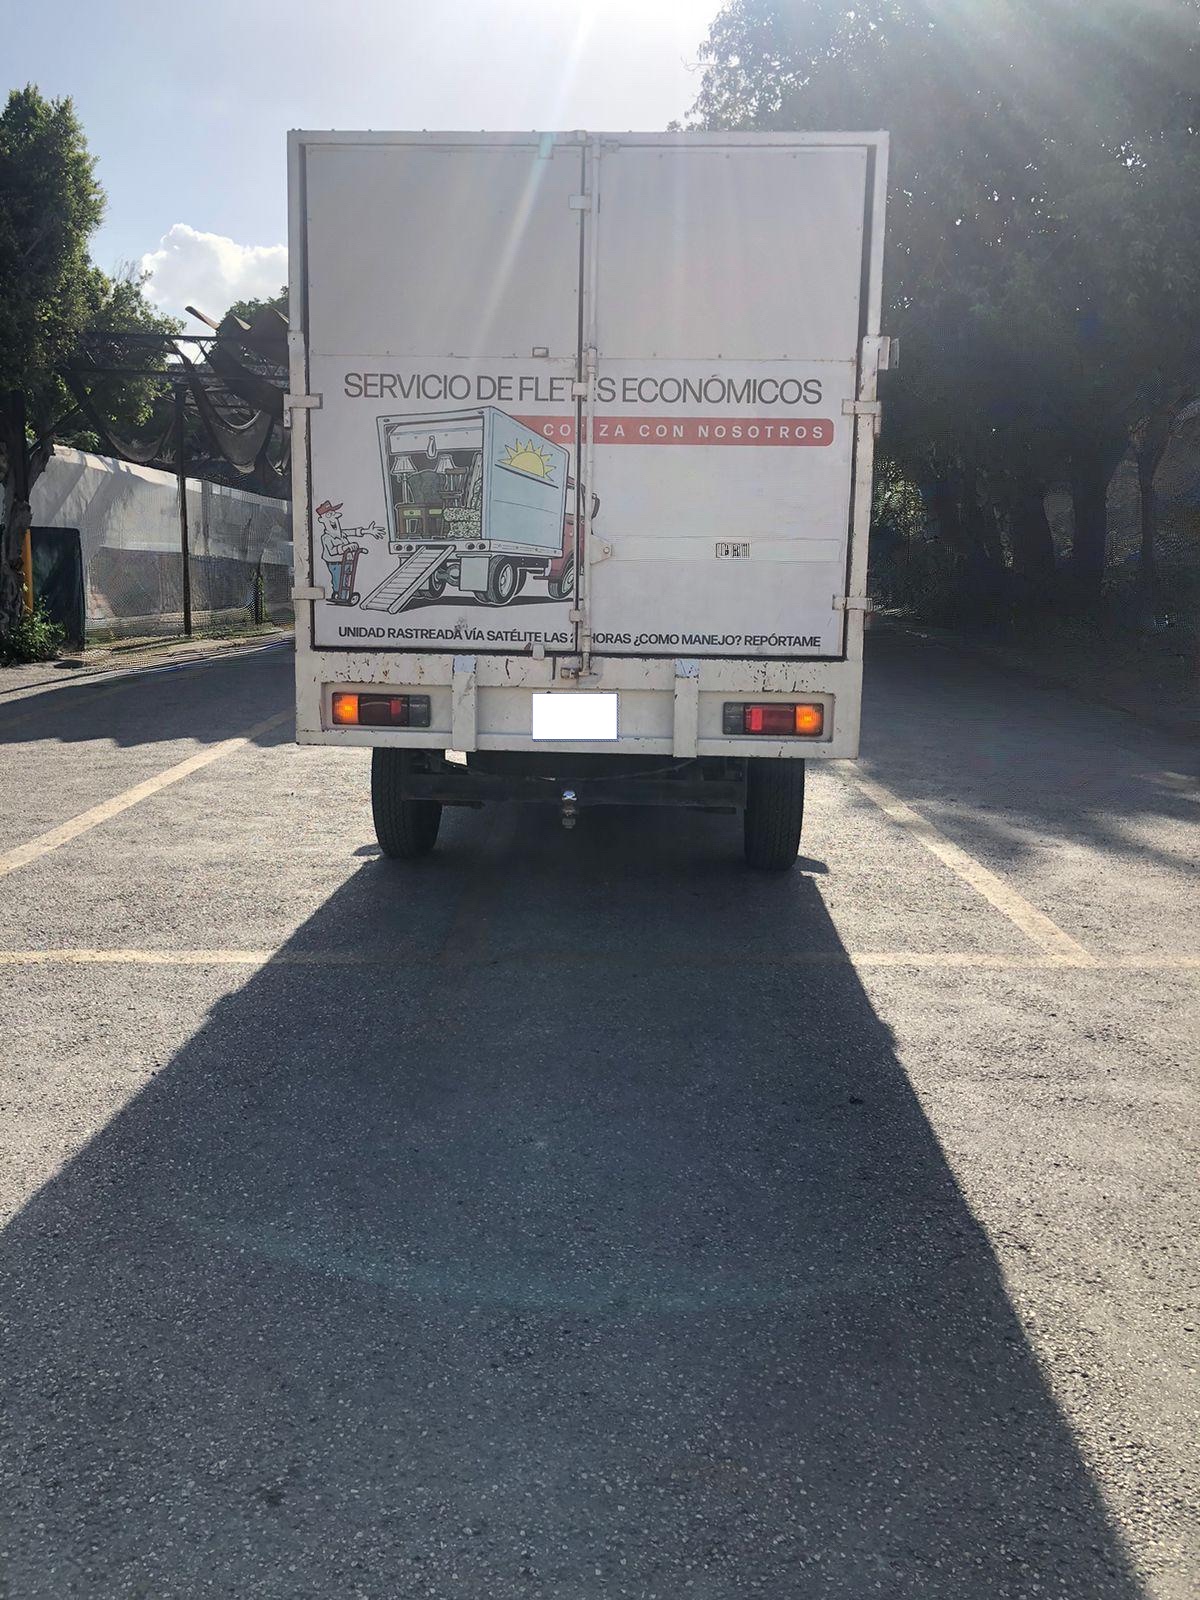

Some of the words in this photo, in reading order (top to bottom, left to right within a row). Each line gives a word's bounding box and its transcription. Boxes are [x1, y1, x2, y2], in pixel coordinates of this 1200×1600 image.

[344, 372, 471, 400] SERVICIO
[476, 375, 514, 401] DE
[518, 376, 616, 403] FLETS
[622, 374, 823, 405] ECONÓMICOS
[543, 423, 625, 437] COZA
[638, 424, 684, 438] CON
[698, 425, 824, 440] NOSOTROS
[338, 626, 386, 639] UNIDAD
[387, 628, 463, 640] RASTREADA
[464, 628, 485, 641] VÍA
[486, 628, 542, 643] SATÉLITE
[544, 632, 568, 643] LAS
[633, 634, 679, 646] ¿COMO
[681, 635, 742, 647] MANEJO?
[744, 633, 821, 647] REPÓRTAME
